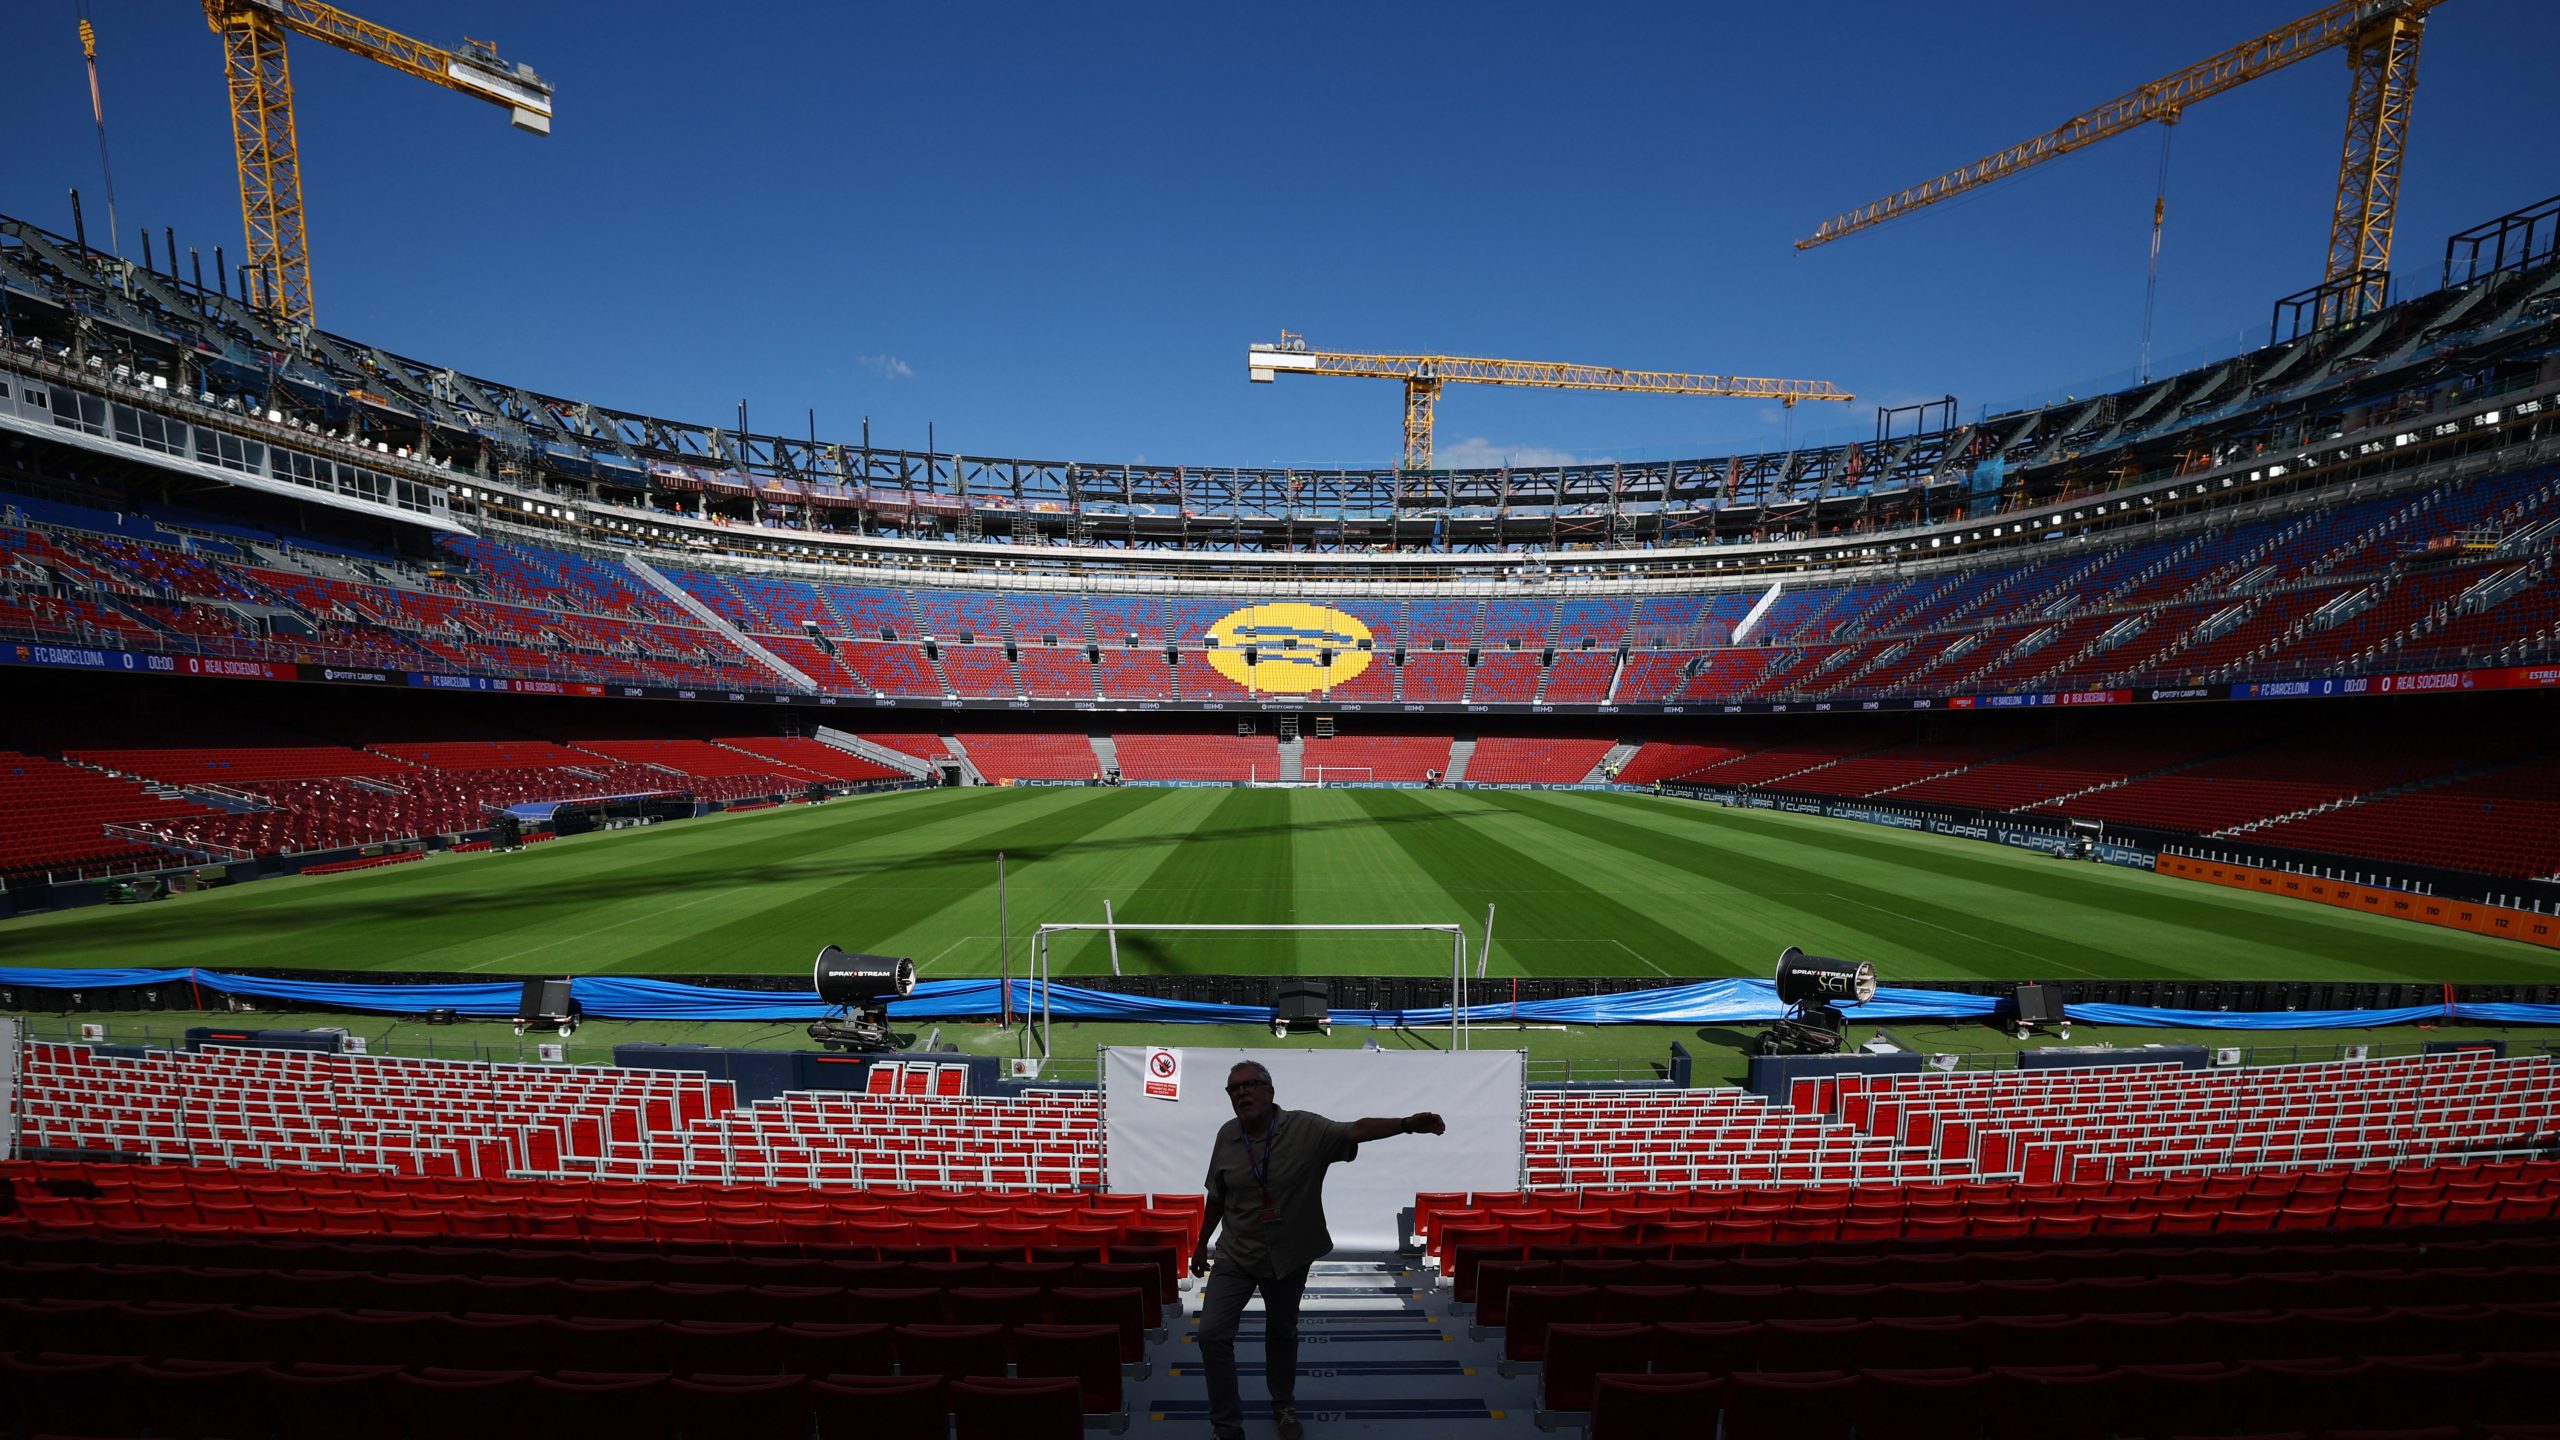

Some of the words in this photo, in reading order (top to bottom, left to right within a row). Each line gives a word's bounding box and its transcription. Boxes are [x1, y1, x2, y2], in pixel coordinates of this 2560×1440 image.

[35, 647, 47, 661] FC
[49, 648, 105, 667] BARCELONA
[122, 653, 133, 669] 0
[148, 656, 175, 671] 00:00
[189, 659, 199, 673] 0
[205, 660, 224, 674] REAL
[225, 662, 260, 676] SOCIEDAD
[333, 669, 357, 681] SPOTIFY
[358, 672, 375, 682] CAMP
[376, 673, 386, 682] NOU
[432, 675, 440, 685] FC
[441, 676, 471, 689] BARCELONA
[479, 678, 486, 690] 0
[515, 681, 522, 691] 0
[524, 681, 535, 691] REAL
[2260, 684, 2270, 695] FC
[2271, 681, 2310, 695] BARCELONA
[2323, 680, 2332, 694] 0
[2344, 679, 2367, 692] 00:00
[2381, 677, 2391, 692] 0
[2397, 675, 2415, 690] REAL
[2417, 673, 2459, 689] SOCIEDAD
[2030, 694, 2036, 705] 0
[2063, 692, 2069, 703] 0
[2159, 690, 2179, 699] SPOTIFY
[2180, 689, 2194, 698] CAMP
[2195, 688, 2208, 697] NOU
[1623, 785, 1654, 794] CUPRA
[1666, 789, 1693, 798] CUPRA
[1786, 802, 1820, 814] CUPRA
[1833, 808, 1869, 821] CUPRA
[1881, 815, 1922, 829] CUPRA
[1937, 822, 1988, 839] CUPRA
[2258, 876, 2273, 886] 104
[2286, 880, 2300, 890] 105
[2311, 884, 2324, 895] 106
[2337, 889, 2350, 900] 107
[2364, 894, 2378, 905] 108
[2394, 899, 2408, 910] 109
[2426, 905, 2440, 916] 110
[2460, 911, 2472, 922] 111
[2495, 916, 2509, 928] 112
[2532, 923, 2548, 935] 113
[1820, 971, 1854, 979] STREAM
[1307, 1336, 1328, 1344] 05
[1311, 1369, 1334, 1378] 06
[1317, 1411, 1342, 1422] 07
